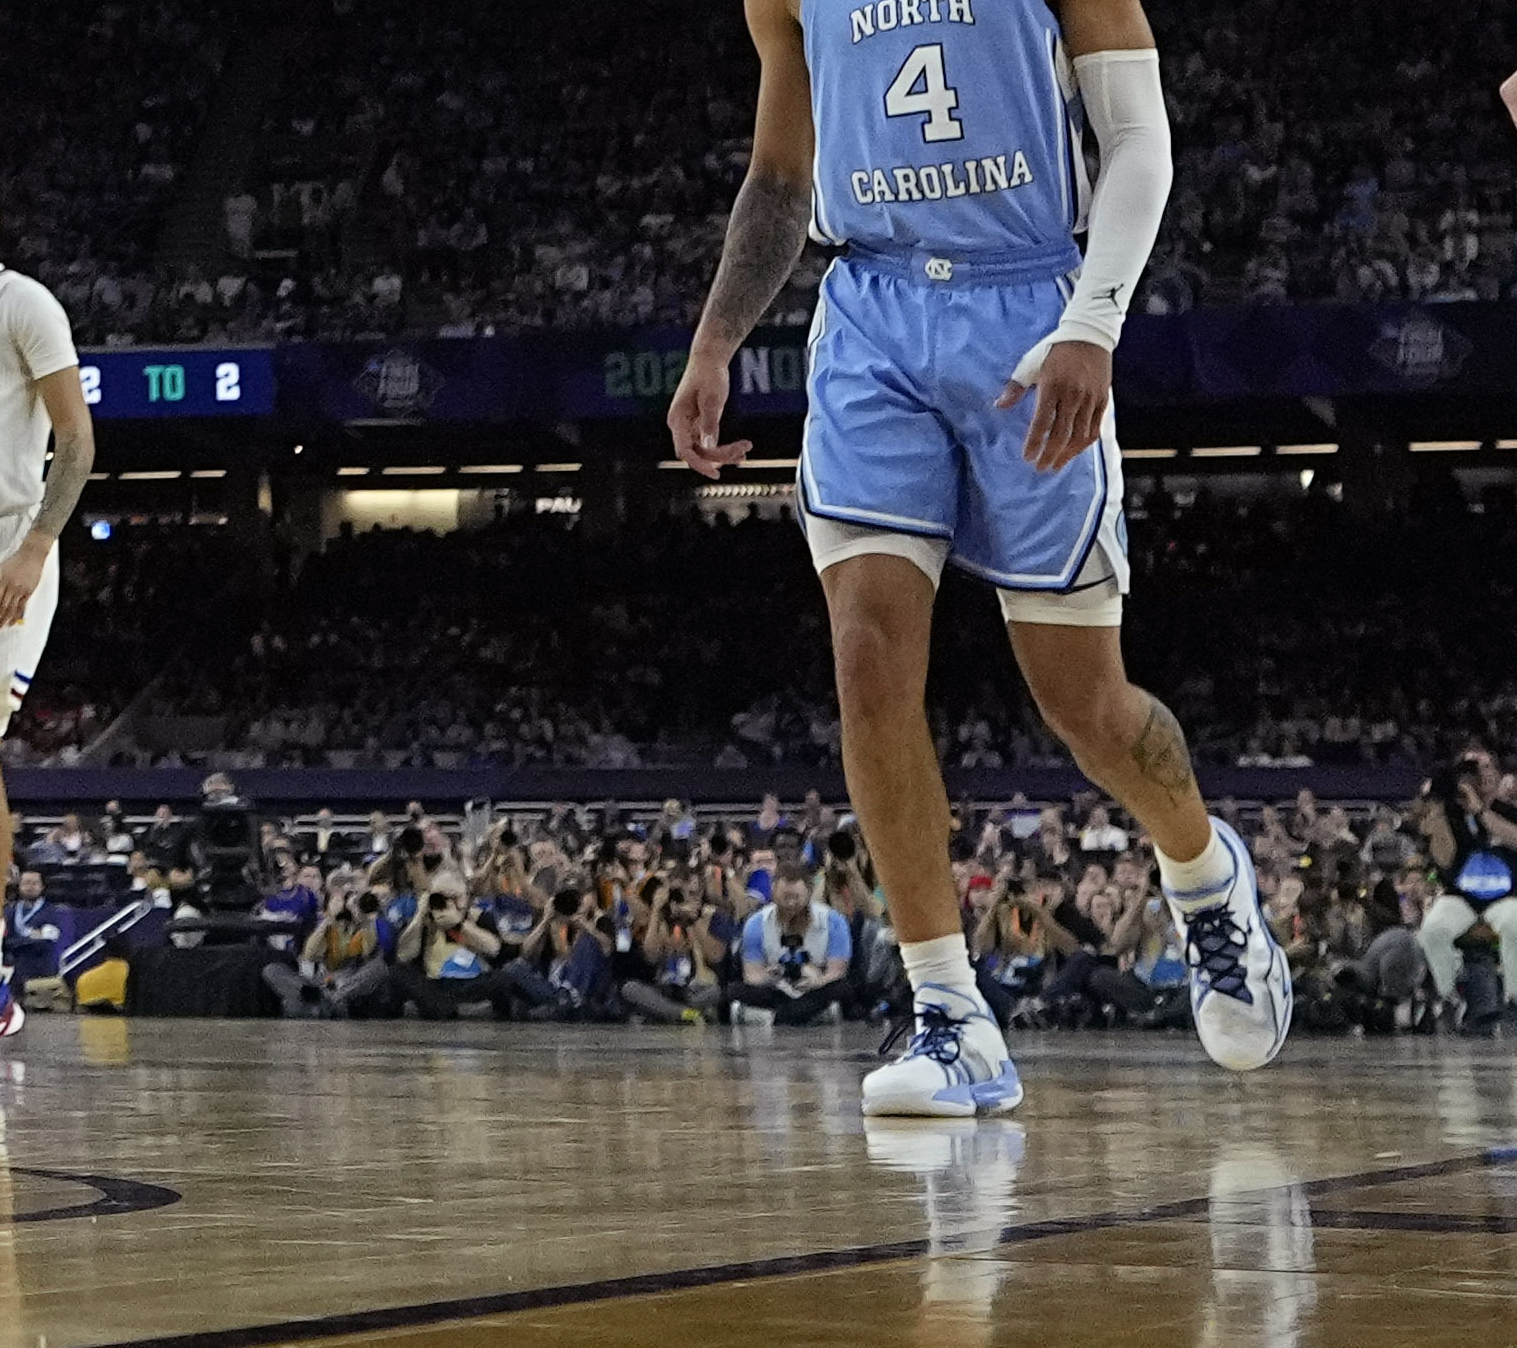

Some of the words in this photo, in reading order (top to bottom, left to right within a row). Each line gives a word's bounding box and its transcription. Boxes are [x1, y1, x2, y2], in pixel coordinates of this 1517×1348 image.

[883, 43, 964, 143] 4
[851, 150, 1033, 204] CAROLINA
[144, 364, 185, 402] TO
[215, 363, 240, 401] 2
